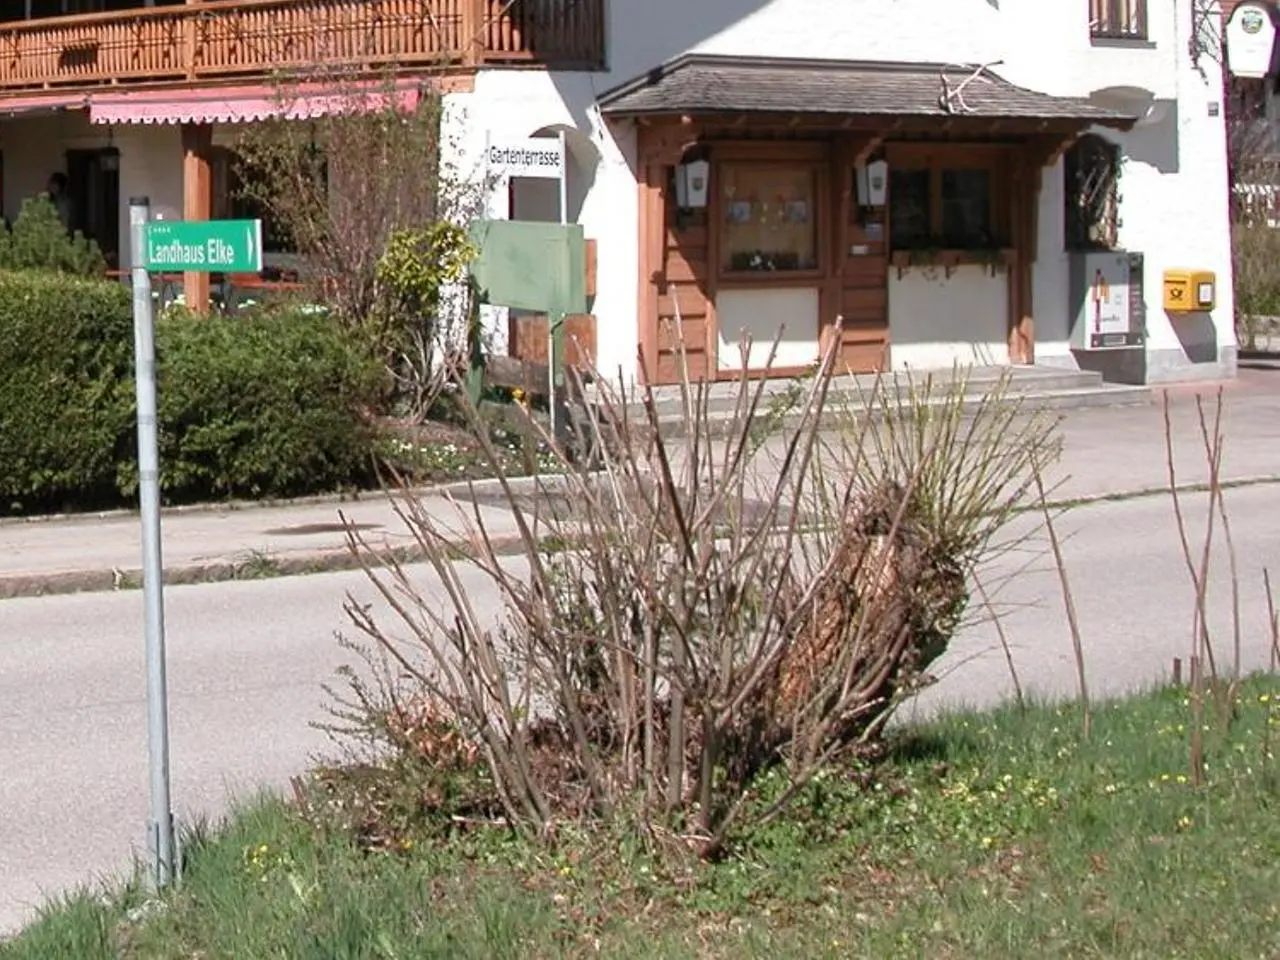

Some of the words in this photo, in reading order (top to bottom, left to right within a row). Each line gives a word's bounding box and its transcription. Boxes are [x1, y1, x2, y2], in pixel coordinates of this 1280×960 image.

[489, 145, 561, 167] Gartenterrasse
[148, 238, 206, 265] Landhaus
[207, 238, 235, 265] Elke
